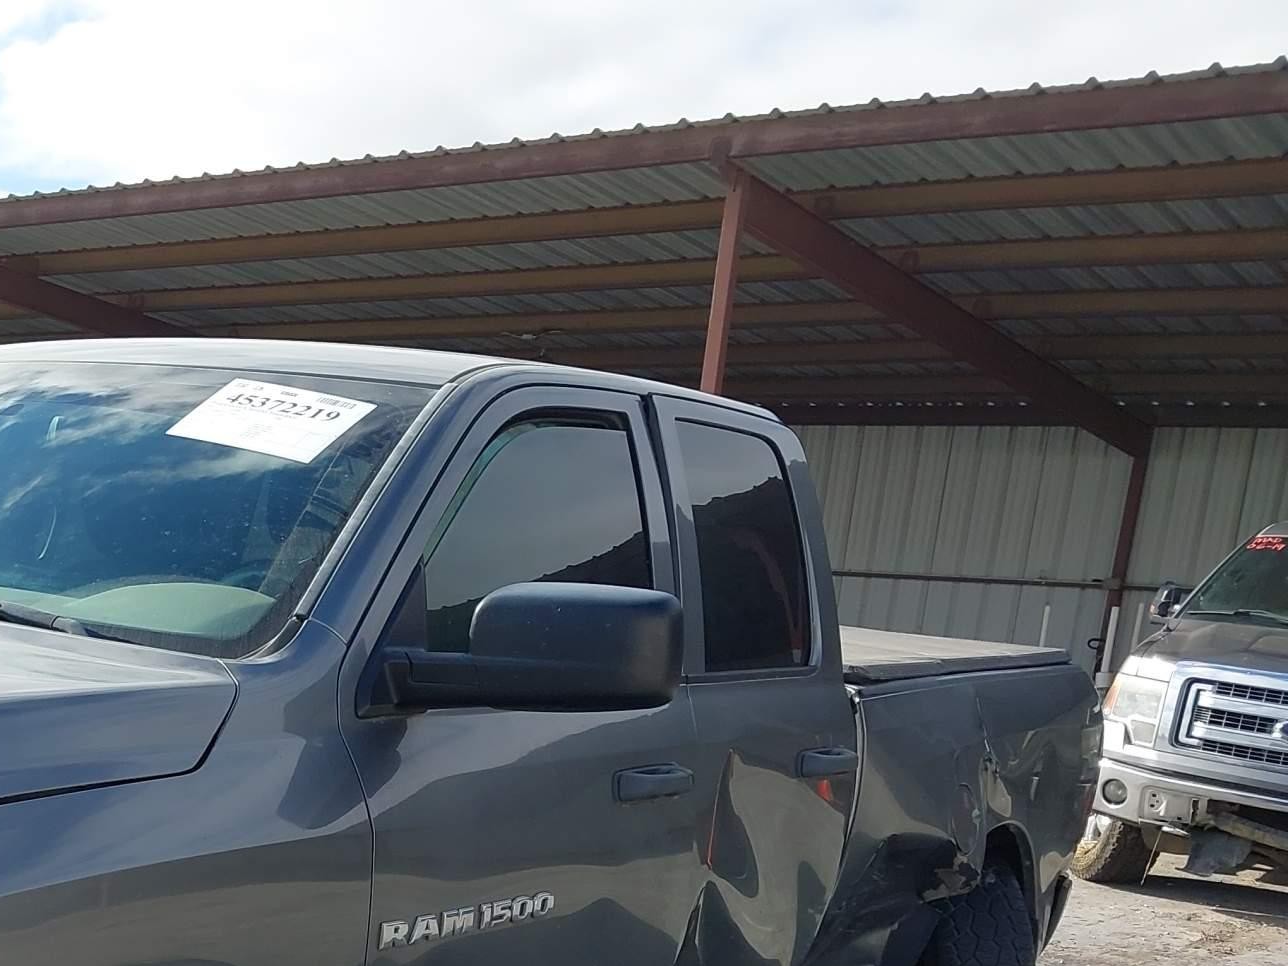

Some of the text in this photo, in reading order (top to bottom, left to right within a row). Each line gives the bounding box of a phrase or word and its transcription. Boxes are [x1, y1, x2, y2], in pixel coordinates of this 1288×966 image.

[226, 393, 341, 421] 45372219
[378, 891, 555, 950] RAM 1500
